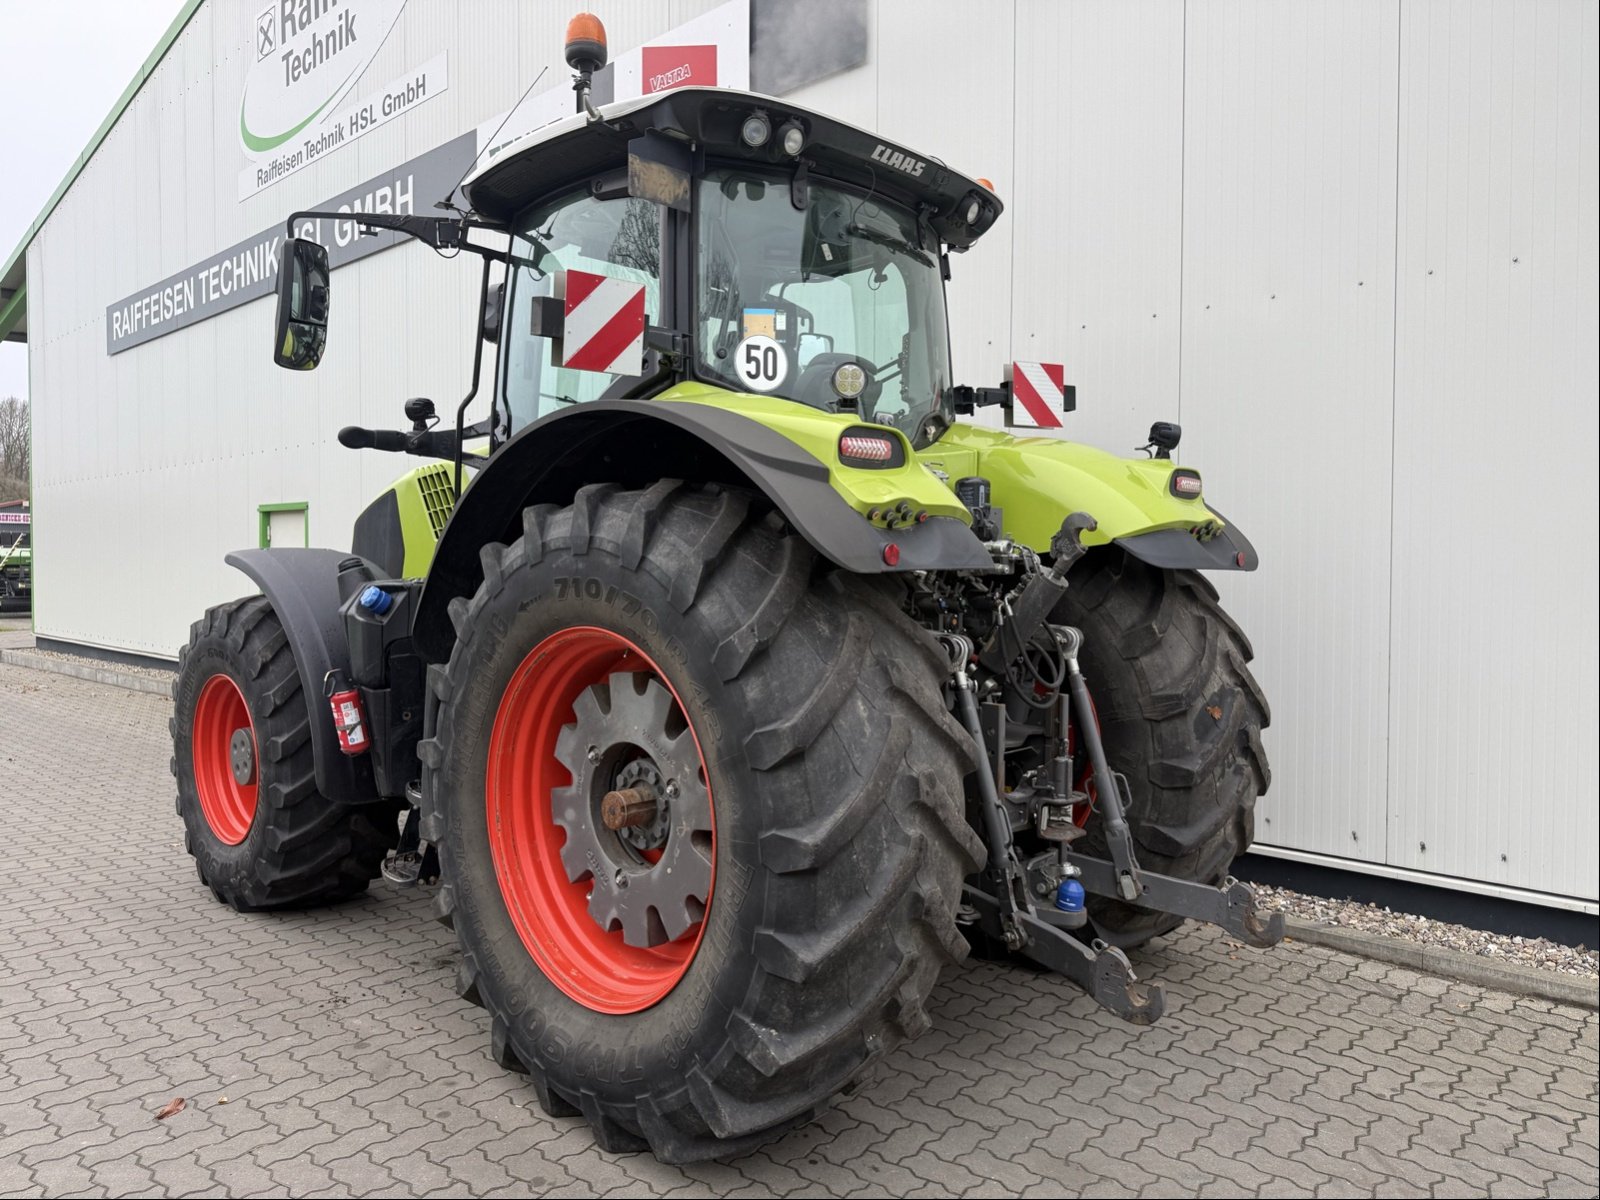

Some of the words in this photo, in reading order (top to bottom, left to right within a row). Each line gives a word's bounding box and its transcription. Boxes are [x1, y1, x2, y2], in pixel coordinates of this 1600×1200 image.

[281, 8, 357, 87] Technik
[649, 63, 692, 93] VALTRA
[256, 151, 303, 188] Raiffeisen
[303, 123, 345, 160] Technik
[349, 104, 377, 136] HSL
[382, 73, 426, 117] GmbH
[870, 144, 927, 177] CLAAS
[112, 279, 195, 341] RAIFFEISEN
[198, 235, 279, 306] TECHNIK
[334, 174, 414, 248] GMBH
[745, 343, 778, 381] 50
[553, 576, 660, 637] 710/70
